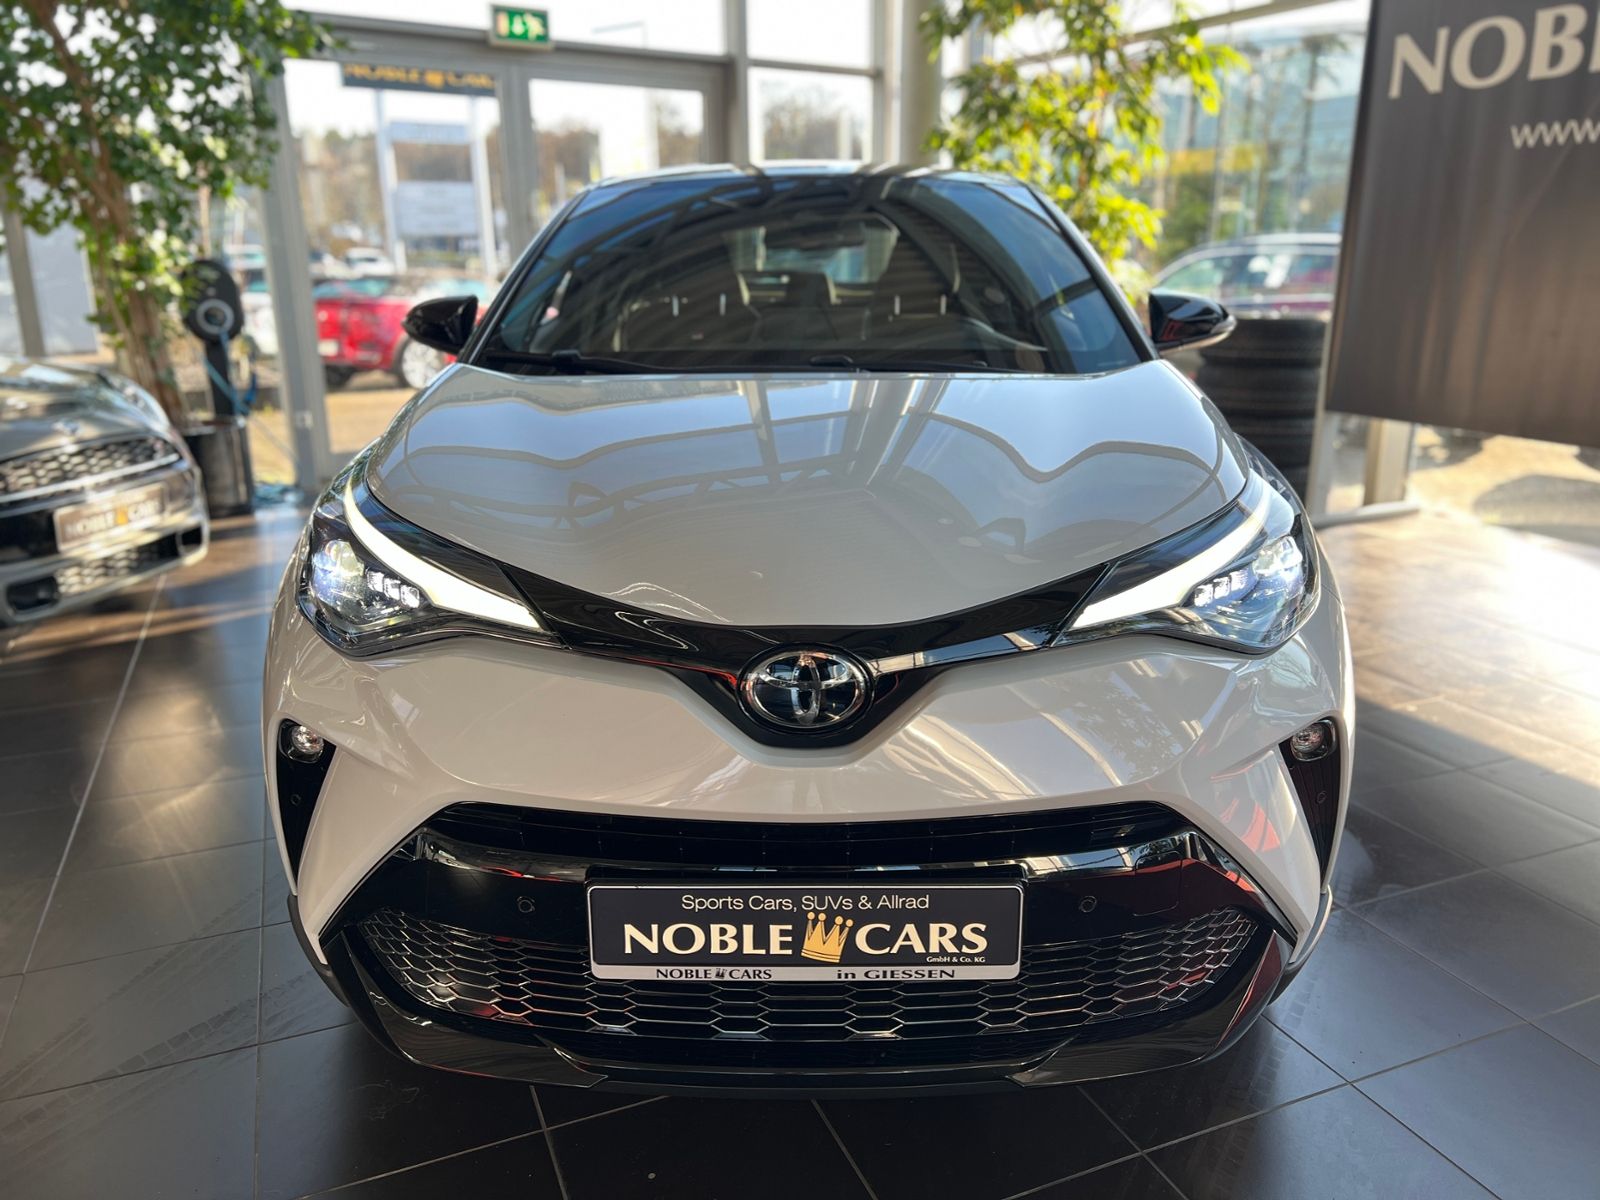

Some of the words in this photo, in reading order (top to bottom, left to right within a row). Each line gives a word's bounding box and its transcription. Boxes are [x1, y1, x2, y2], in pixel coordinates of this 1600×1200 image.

[681, 894, 744, 912] Sports
[748, 895, 797, 912] Cars,
[801, 895, 853, 910] SUVs
[857, 895, 872, 910] &
[876, 894, 929, 909] Allrad
[624, 923, 793, 955] NOBLE
[855, 923, 988, 955] CARS
[656, 968, 712, 979] NOBLE
[729, 969, 772, 980] CARS
[837, 969, 856, 979] in
[863, 969, 955, 979] GIESSEN
